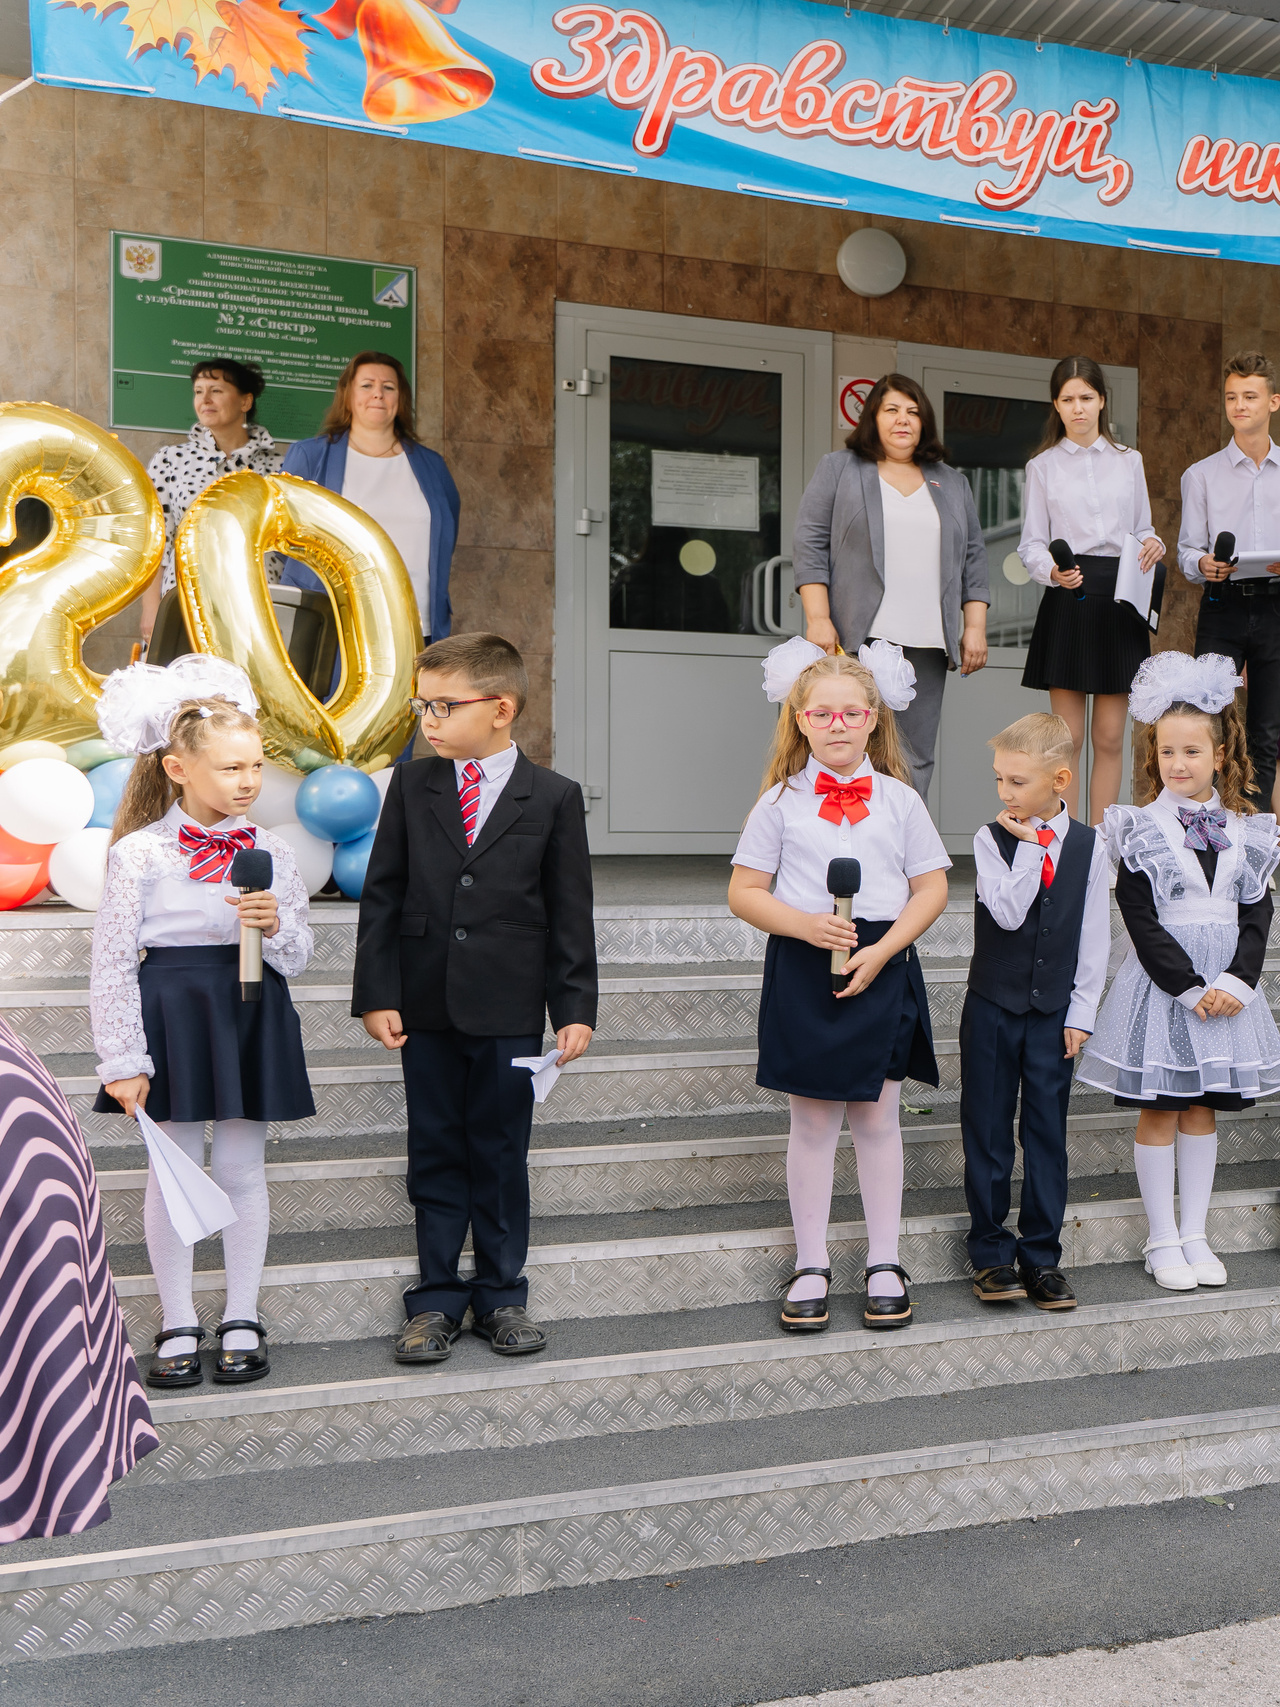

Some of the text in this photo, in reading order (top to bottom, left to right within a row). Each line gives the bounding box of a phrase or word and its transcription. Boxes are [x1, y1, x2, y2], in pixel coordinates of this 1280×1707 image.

[530, 3, 1133, 212] Здравствуй,
[206, 252, 328, 273] АДМИНИСТРАЦИЯ ГОРОДА БЕРДСКА
[219, 260, 315, 277] НОВОСИБИРСКОЙ ОБЛАСТИ
[187, 278, 345, 302] ОБЩЕОБРАЗОВАТЕЛЬНОЕ УЧРЕЖДЕНИЕ
[202, 271, 331, 292] МУНИЦИПАЛЬНОЕ БЮДЖЕТНОЕ
[136, 293, 392, 329] с углубленным изучением отдельных предметов
[161, 284, 369, 316] «Средняя общеобразовательная школа
[215, 326, 243, 336] (МБОУ
[243, 329, 267, 339] СОШ
[216, 311, 317, 336] № 2 «Спектр»
[172, 338, 197, 348] Режим
[198, 342, 226, 351] работы:
[228, 345, 275, 356] понедельник
[280, 351, 310, 360] пятница
[183, 349, 211, 358] суббота
[267, 358, 310, 368] воскресенье
